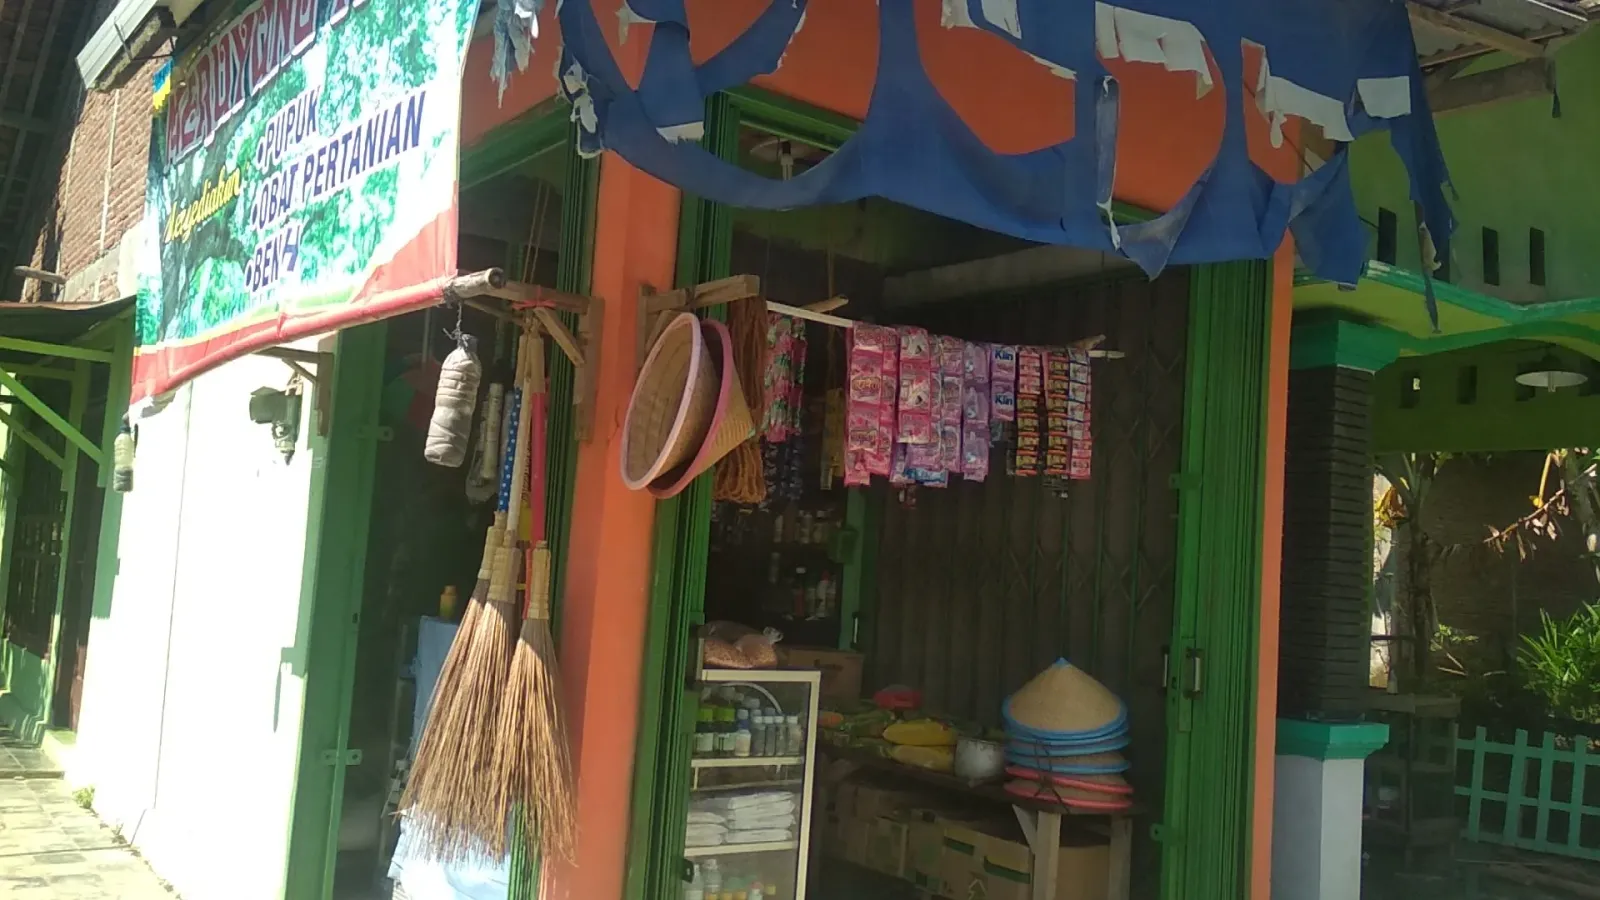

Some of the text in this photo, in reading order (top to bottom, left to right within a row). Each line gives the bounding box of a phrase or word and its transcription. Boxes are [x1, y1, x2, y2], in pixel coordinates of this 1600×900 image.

[266, 87, 320, 163] PUPUK
[257, 91, 427, 231] OBAT PERTANIAN
[995, 349, 1014, 361] Klin
[995, 395, 1013, 406] Klin
